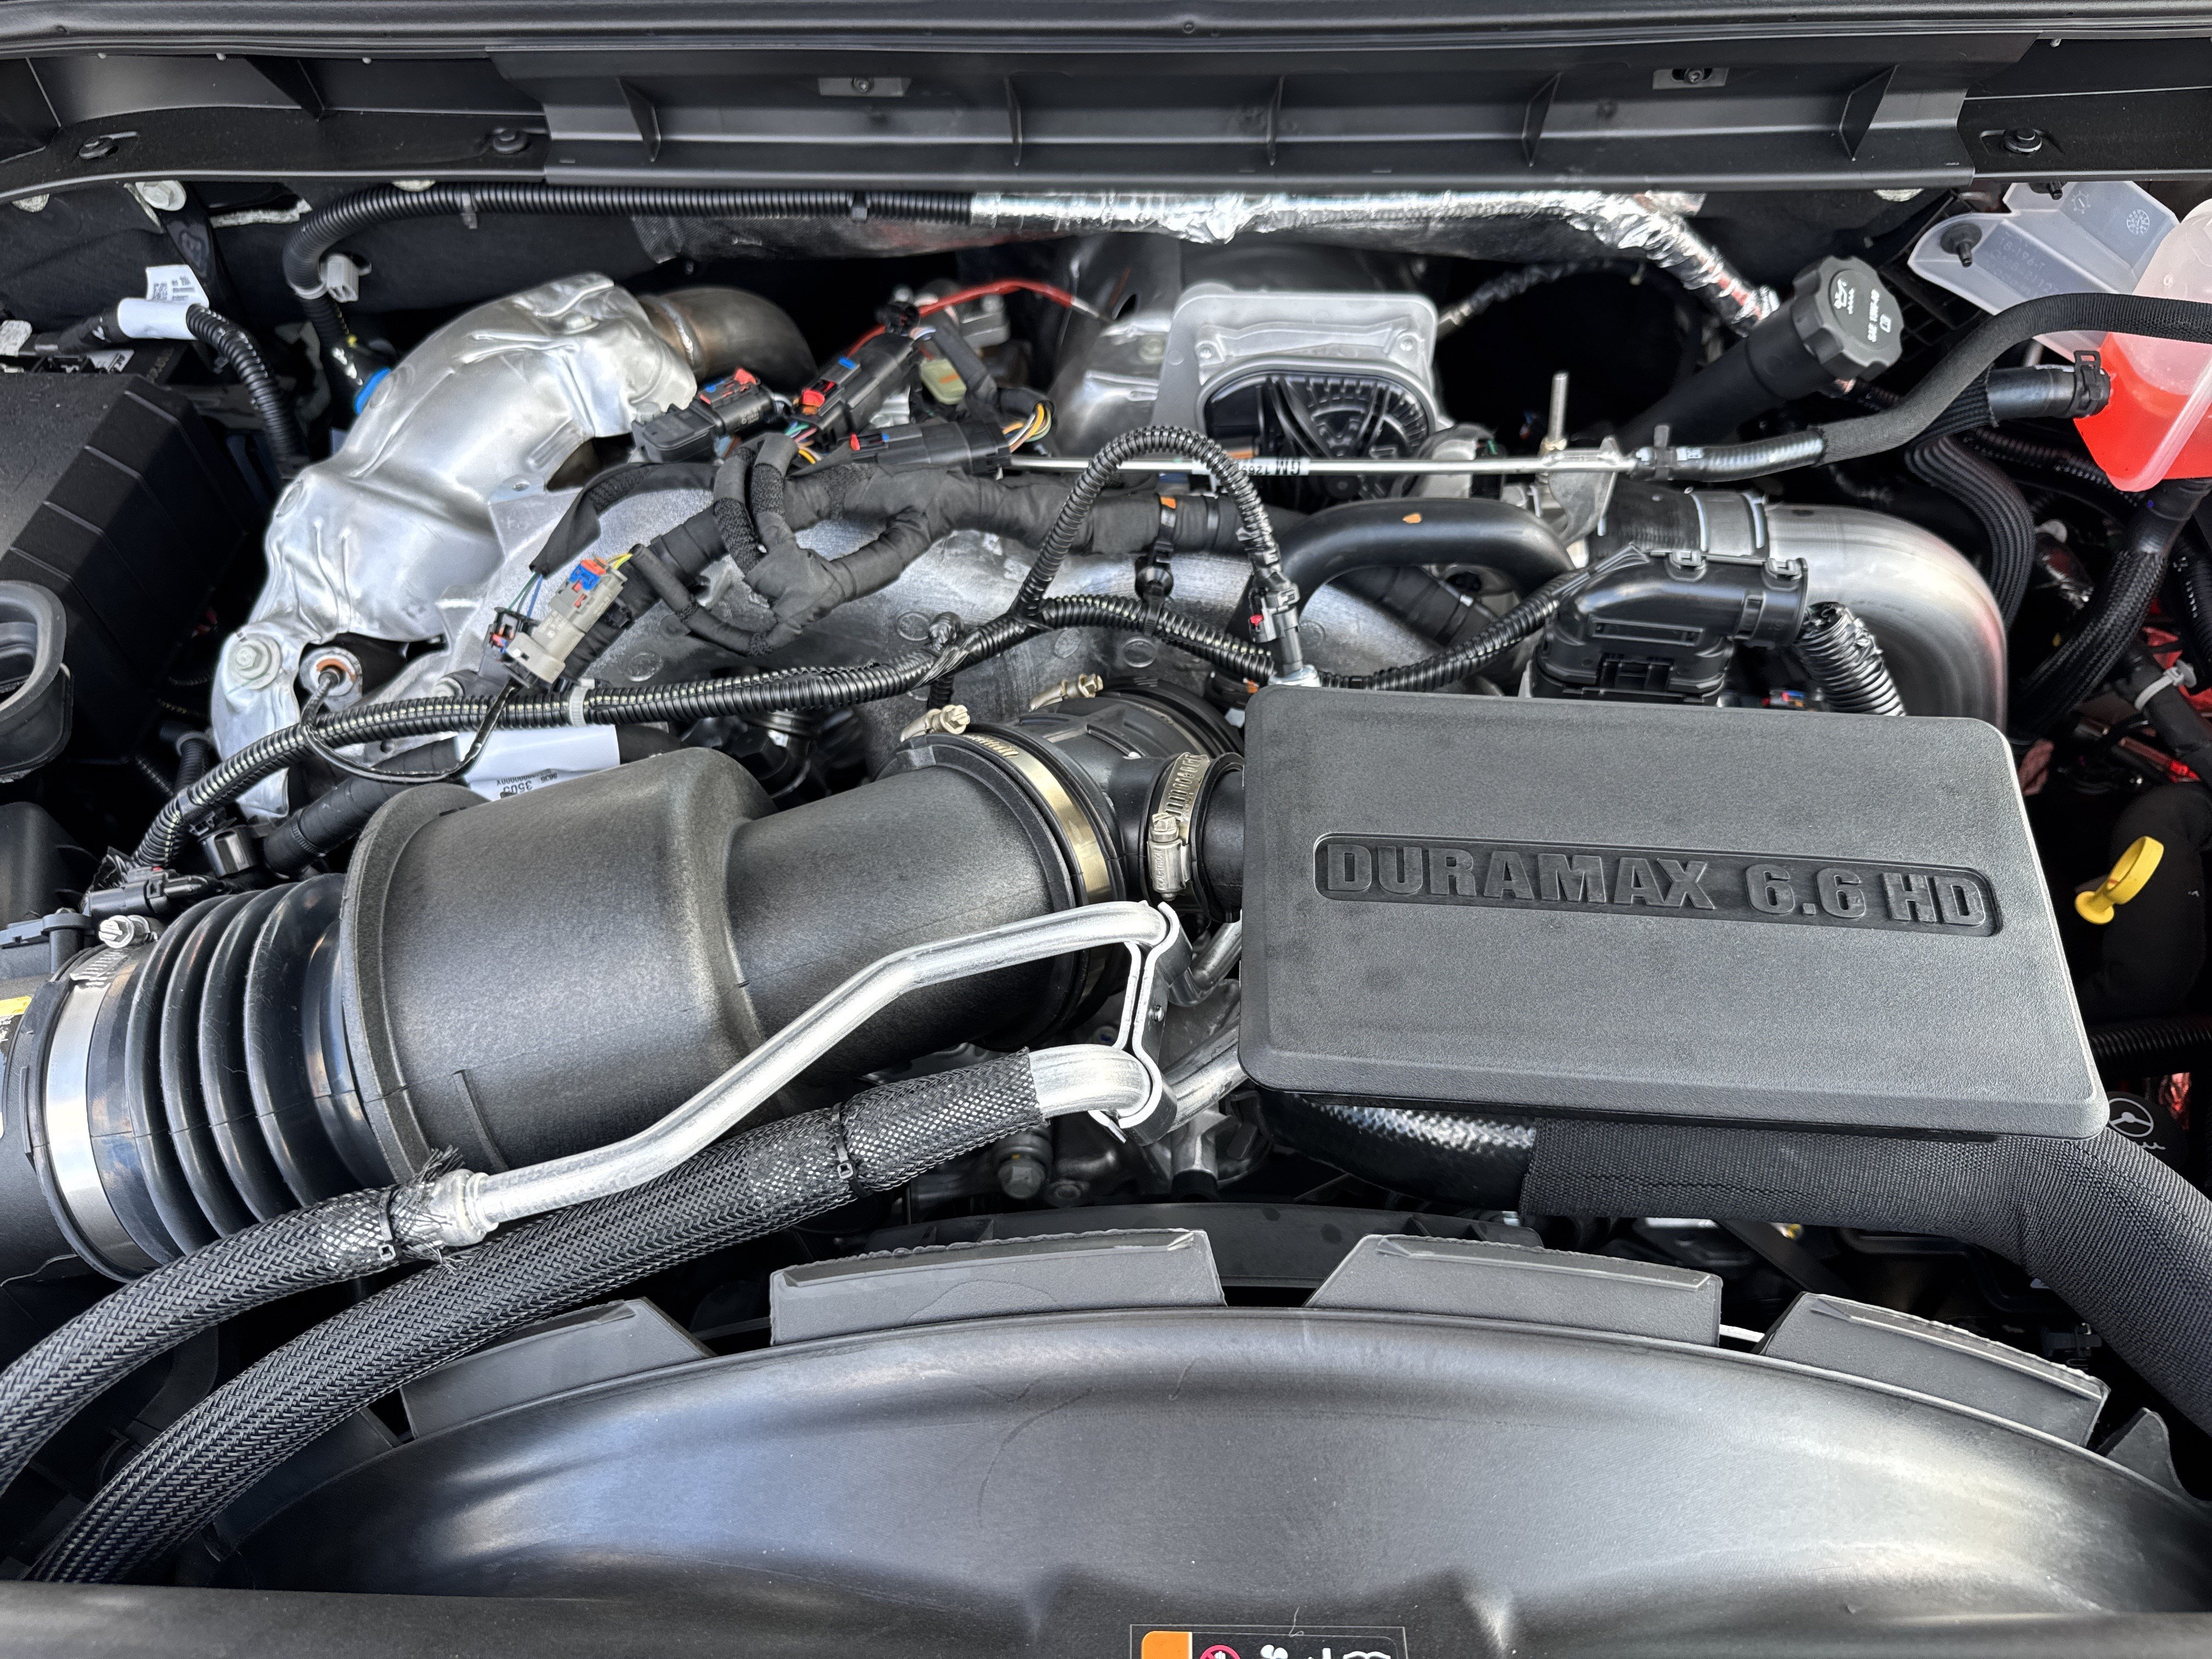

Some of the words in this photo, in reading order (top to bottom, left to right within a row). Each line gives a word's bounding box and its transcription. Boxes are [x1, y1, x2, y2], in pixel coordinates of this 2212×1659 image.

[1276, 460, 1300, 476] GM
[1327, 844, 1715, 910] DURAMAX
[1746, 863, 1865, 919] 6.6
[1882, 872, 1986, 927] HD
